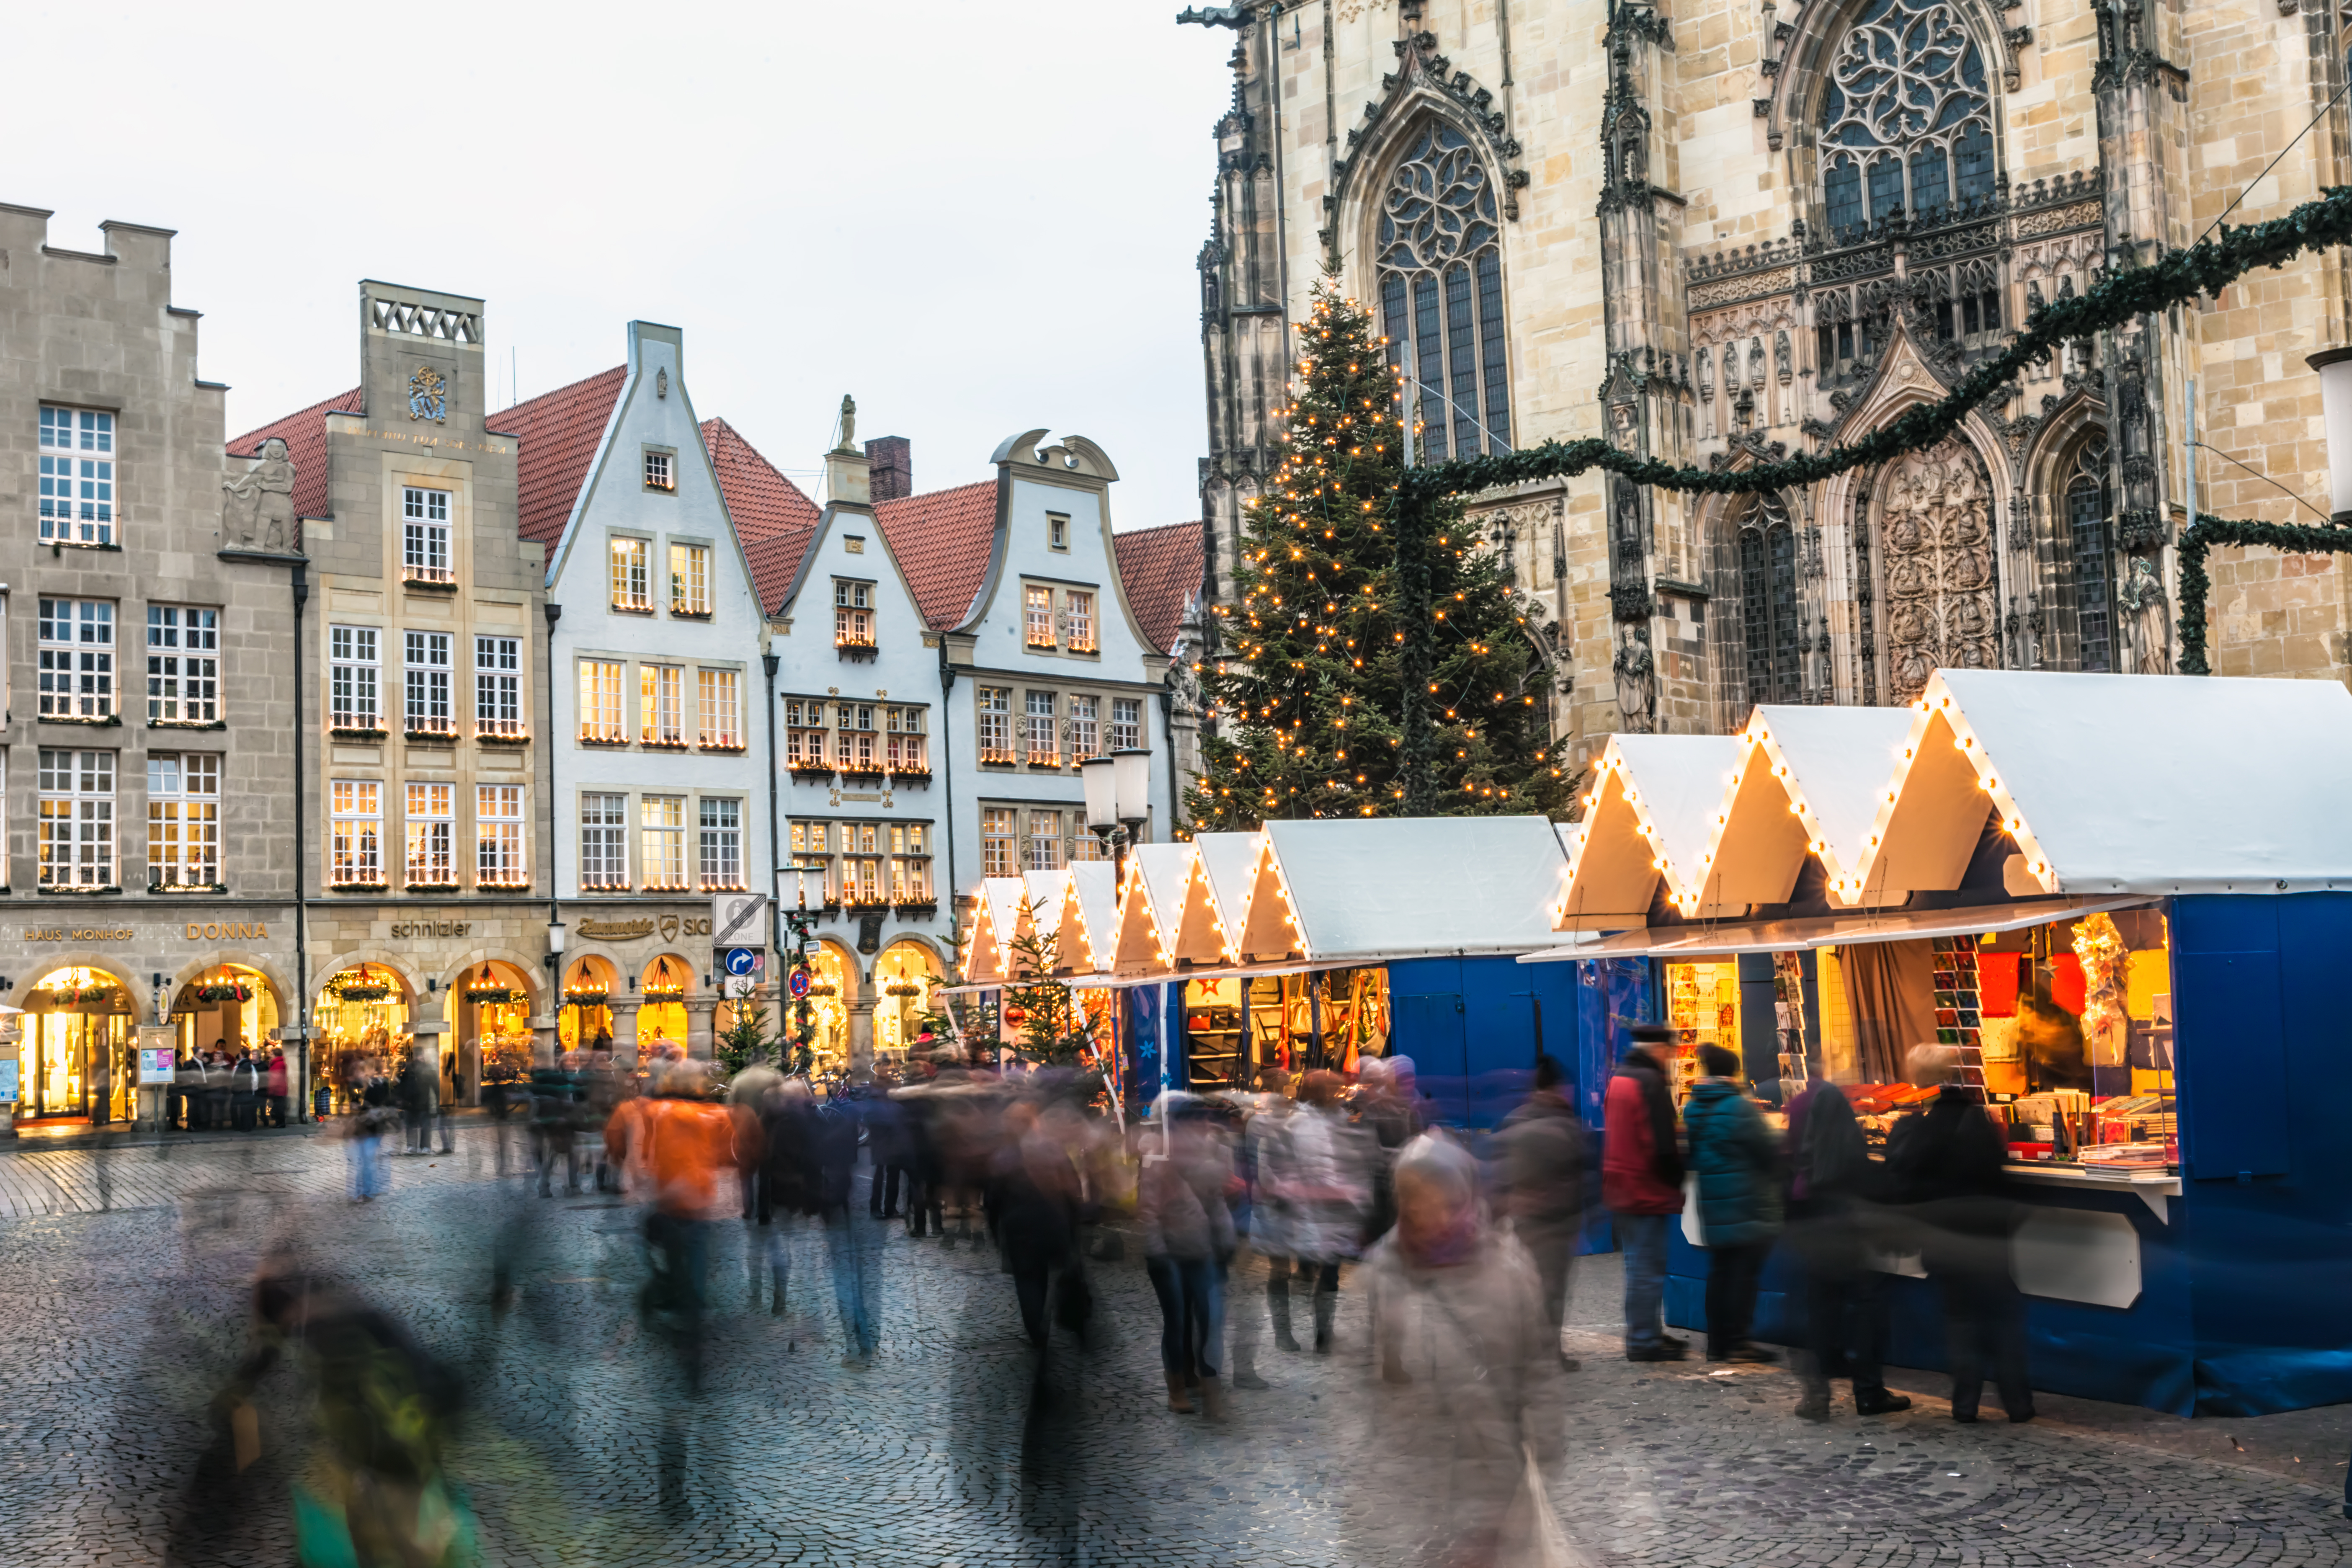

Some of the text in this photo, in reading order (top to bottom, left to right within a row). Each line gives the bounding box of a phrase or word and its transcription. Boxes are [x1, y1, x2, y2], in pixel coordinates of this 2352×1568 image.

[348, 426, 506, 454] IN MANU TUA SORS MEA
[25, 929, 133, 941] HAUS MONHOF
[187, 922, 268, 939] DONNA
[391, 919, 472, 937] schnitzler
[728, 933, 754, 941] ZONE
